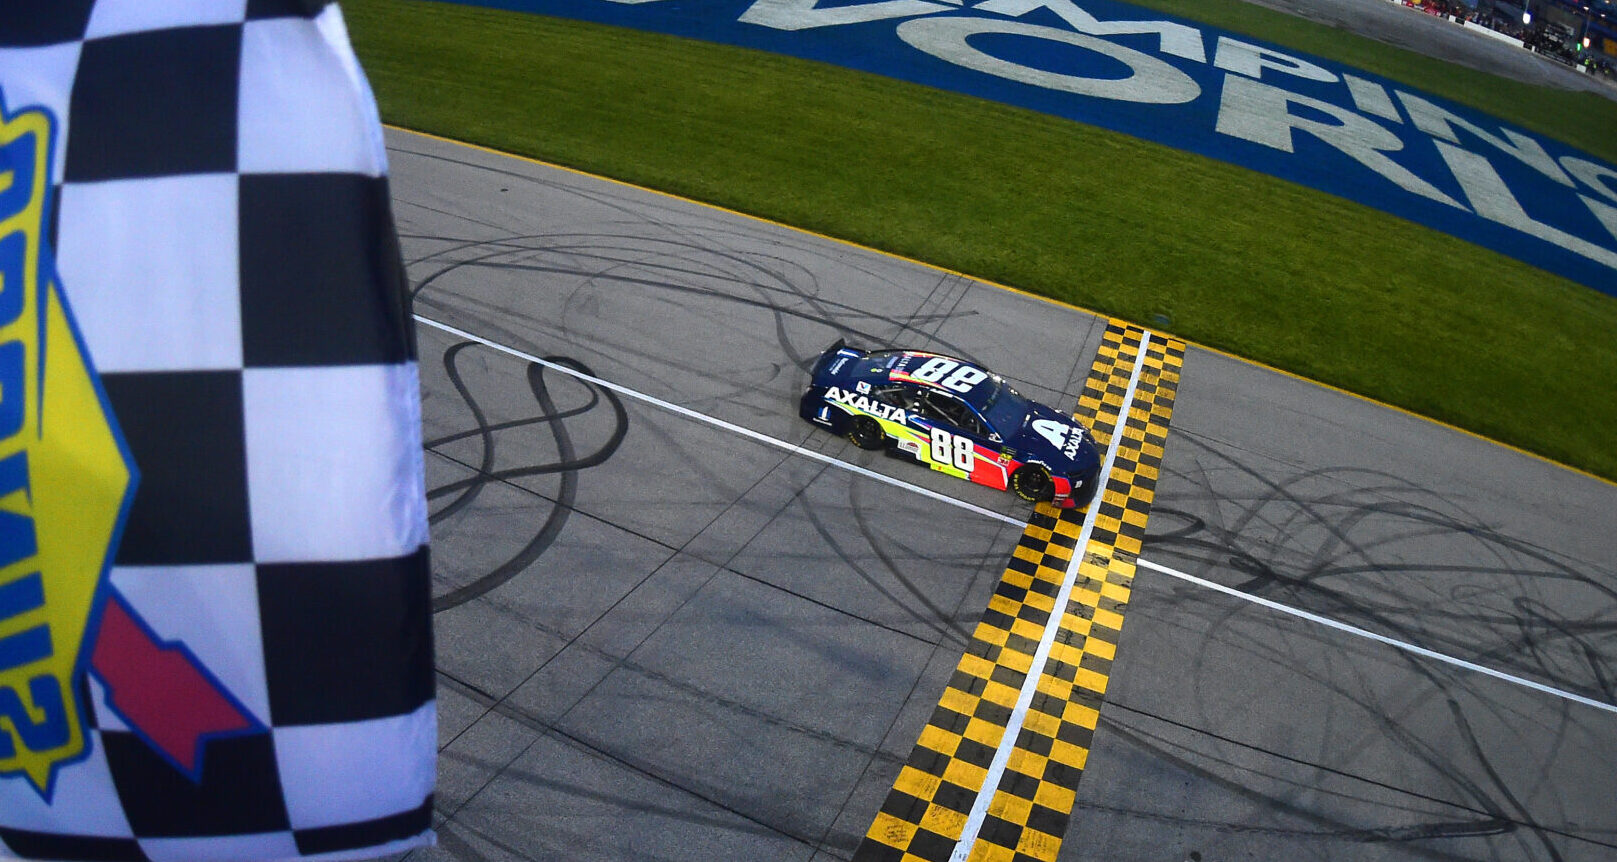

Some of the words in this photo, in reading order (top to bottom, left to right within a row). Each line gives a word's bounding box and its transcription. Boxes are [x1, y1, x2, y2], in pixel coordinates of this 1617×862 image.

[824, 386, 907, 426] AXALTA
[930, 427, 976, 473] 88
[1063, 427, 1085, 461] AXALTA
